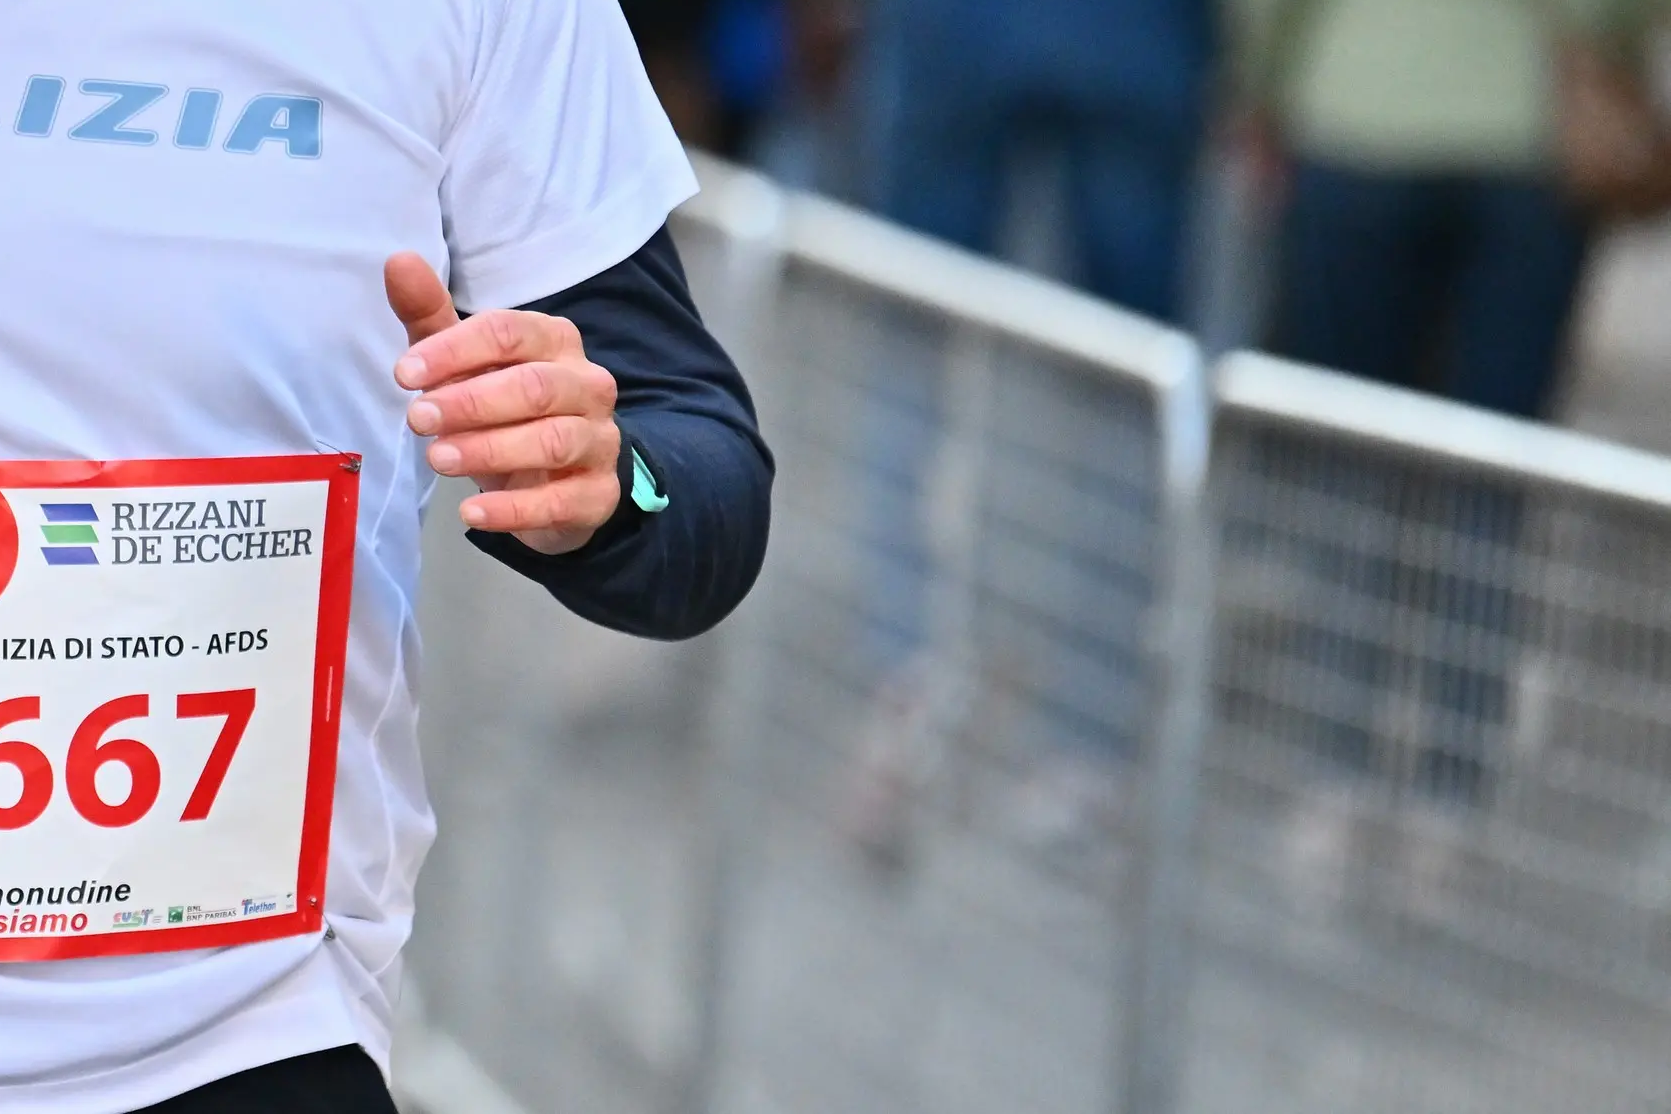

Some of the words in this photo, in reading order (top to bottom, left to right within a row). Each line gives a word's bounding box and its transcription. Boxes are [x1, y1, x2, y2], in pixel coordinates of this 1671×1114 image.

[111, 499, 267, 531] RIZZANI
[112, 536, 163, 565] DE
[172, 530, 312, 564] ECCHER
[64, 637, 93, 659] DI
[100, 636, 185, 658] STATO
[206, 629, 269, 655] AFDS
[187, 914, 203, 922] BNP
[205, 910, 237, 920] PARIBAS
